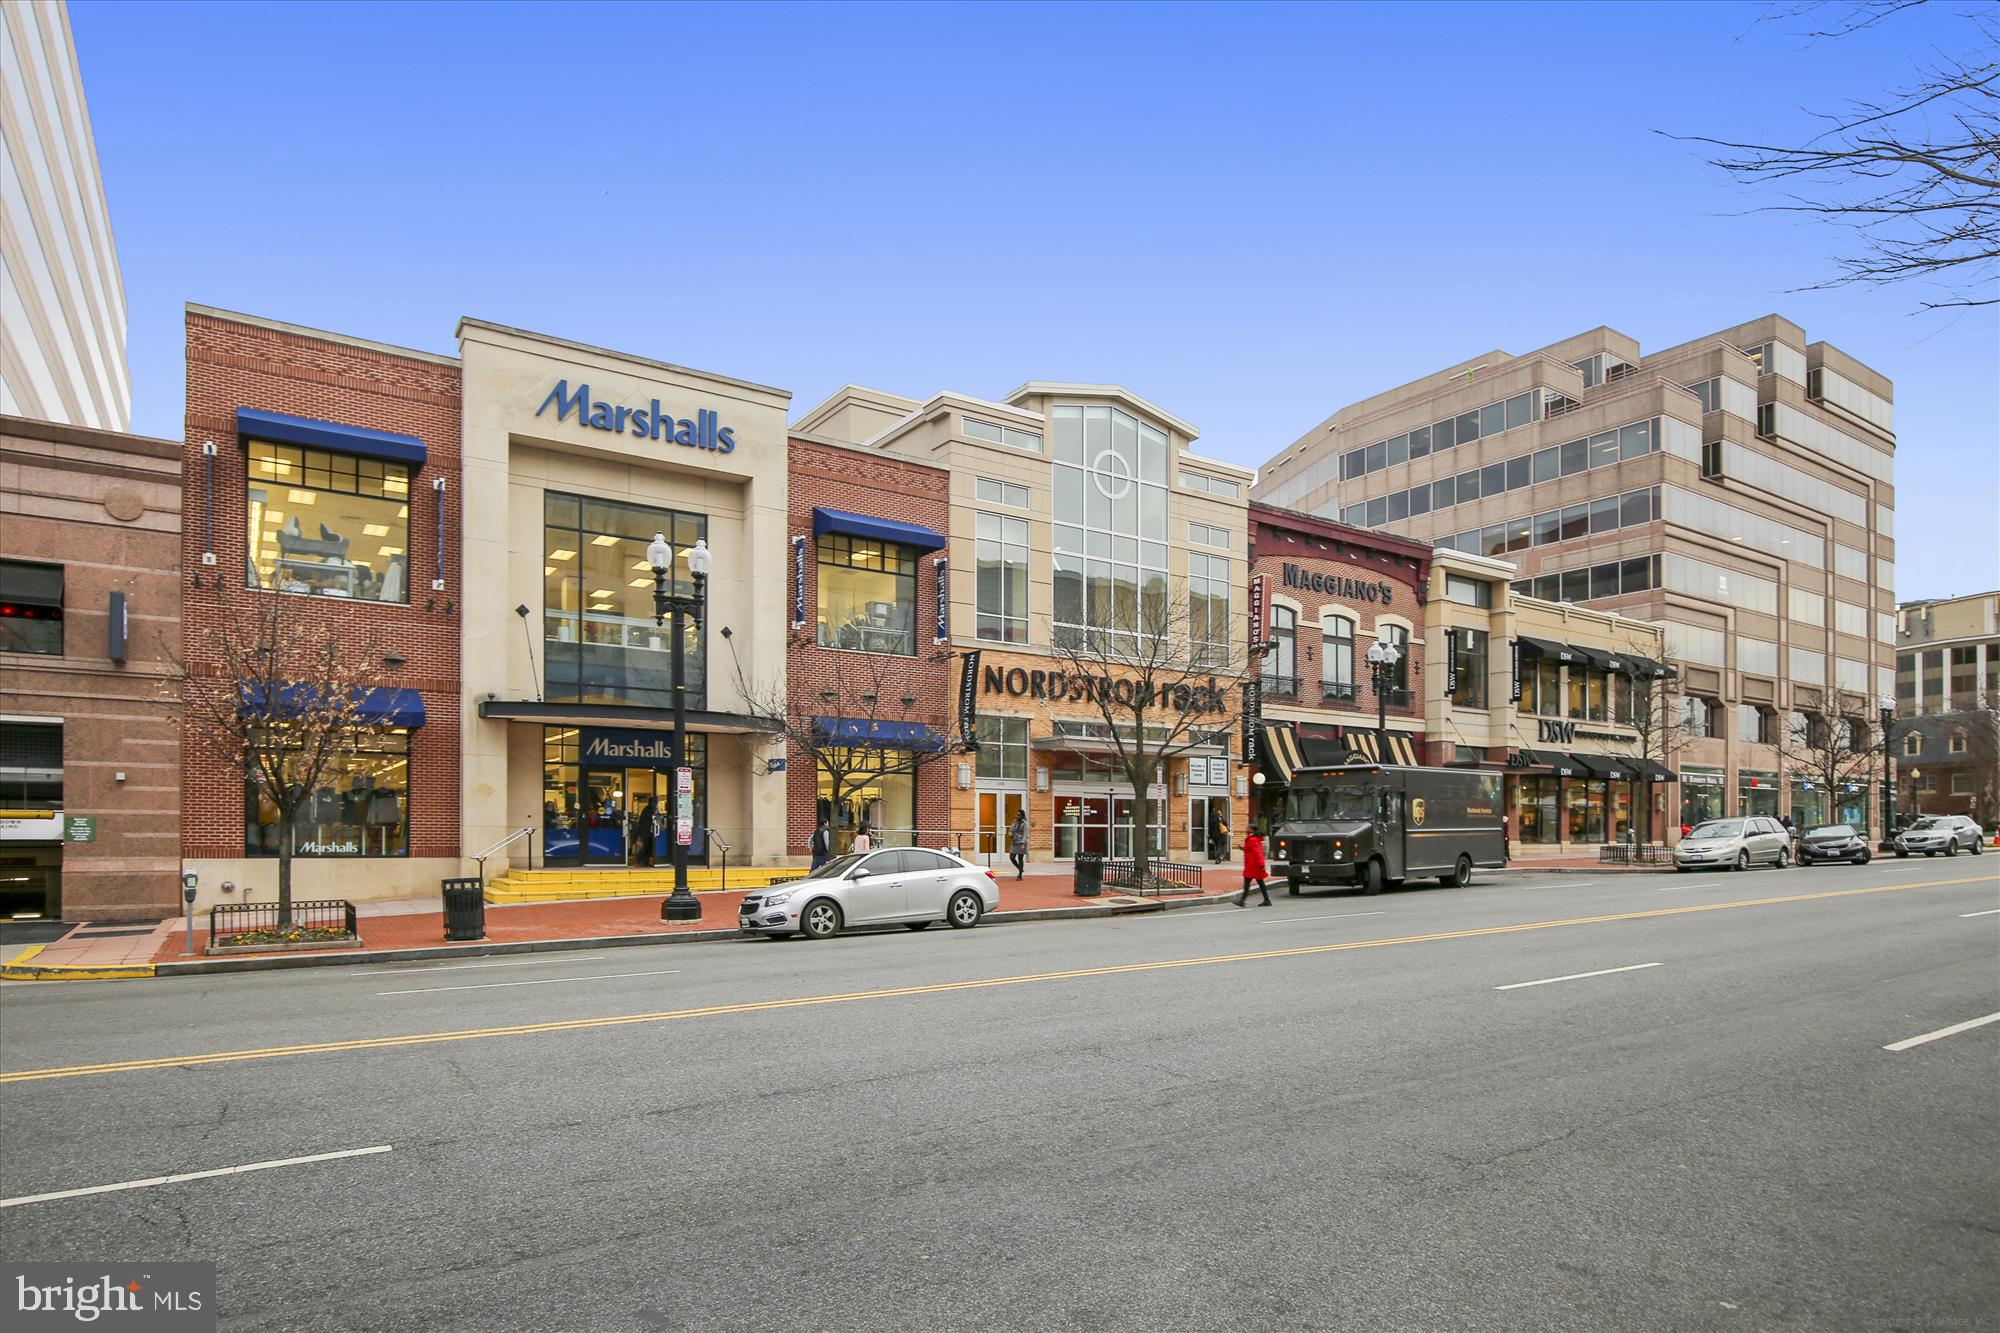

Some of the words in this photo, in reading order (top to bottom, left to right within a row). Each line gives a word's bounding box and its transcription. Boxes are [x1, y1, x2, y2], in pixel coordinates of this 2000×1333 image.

[535, 379, 735, 453] Marshalls
[937, 569, 945, 630] Marshalls
[1283, 562, 1393, 605] MAGGIANO'S
[1252, 578, 1261, 643] MAGGIANO'S
[963, 654, 975, 714] NORDSTROM
[985, 664, 1156, 708] NORDSTROM
[1162, 676, 1227, 713] rack
[586, 738, 672, 758] Marshalls
[1248, 736, 1256, 760] rack
[1538, 719, 1575, 744] DSW
[1510, 752, 1531, 768] DSW
[299, 841, 358, 853] Marshalls
